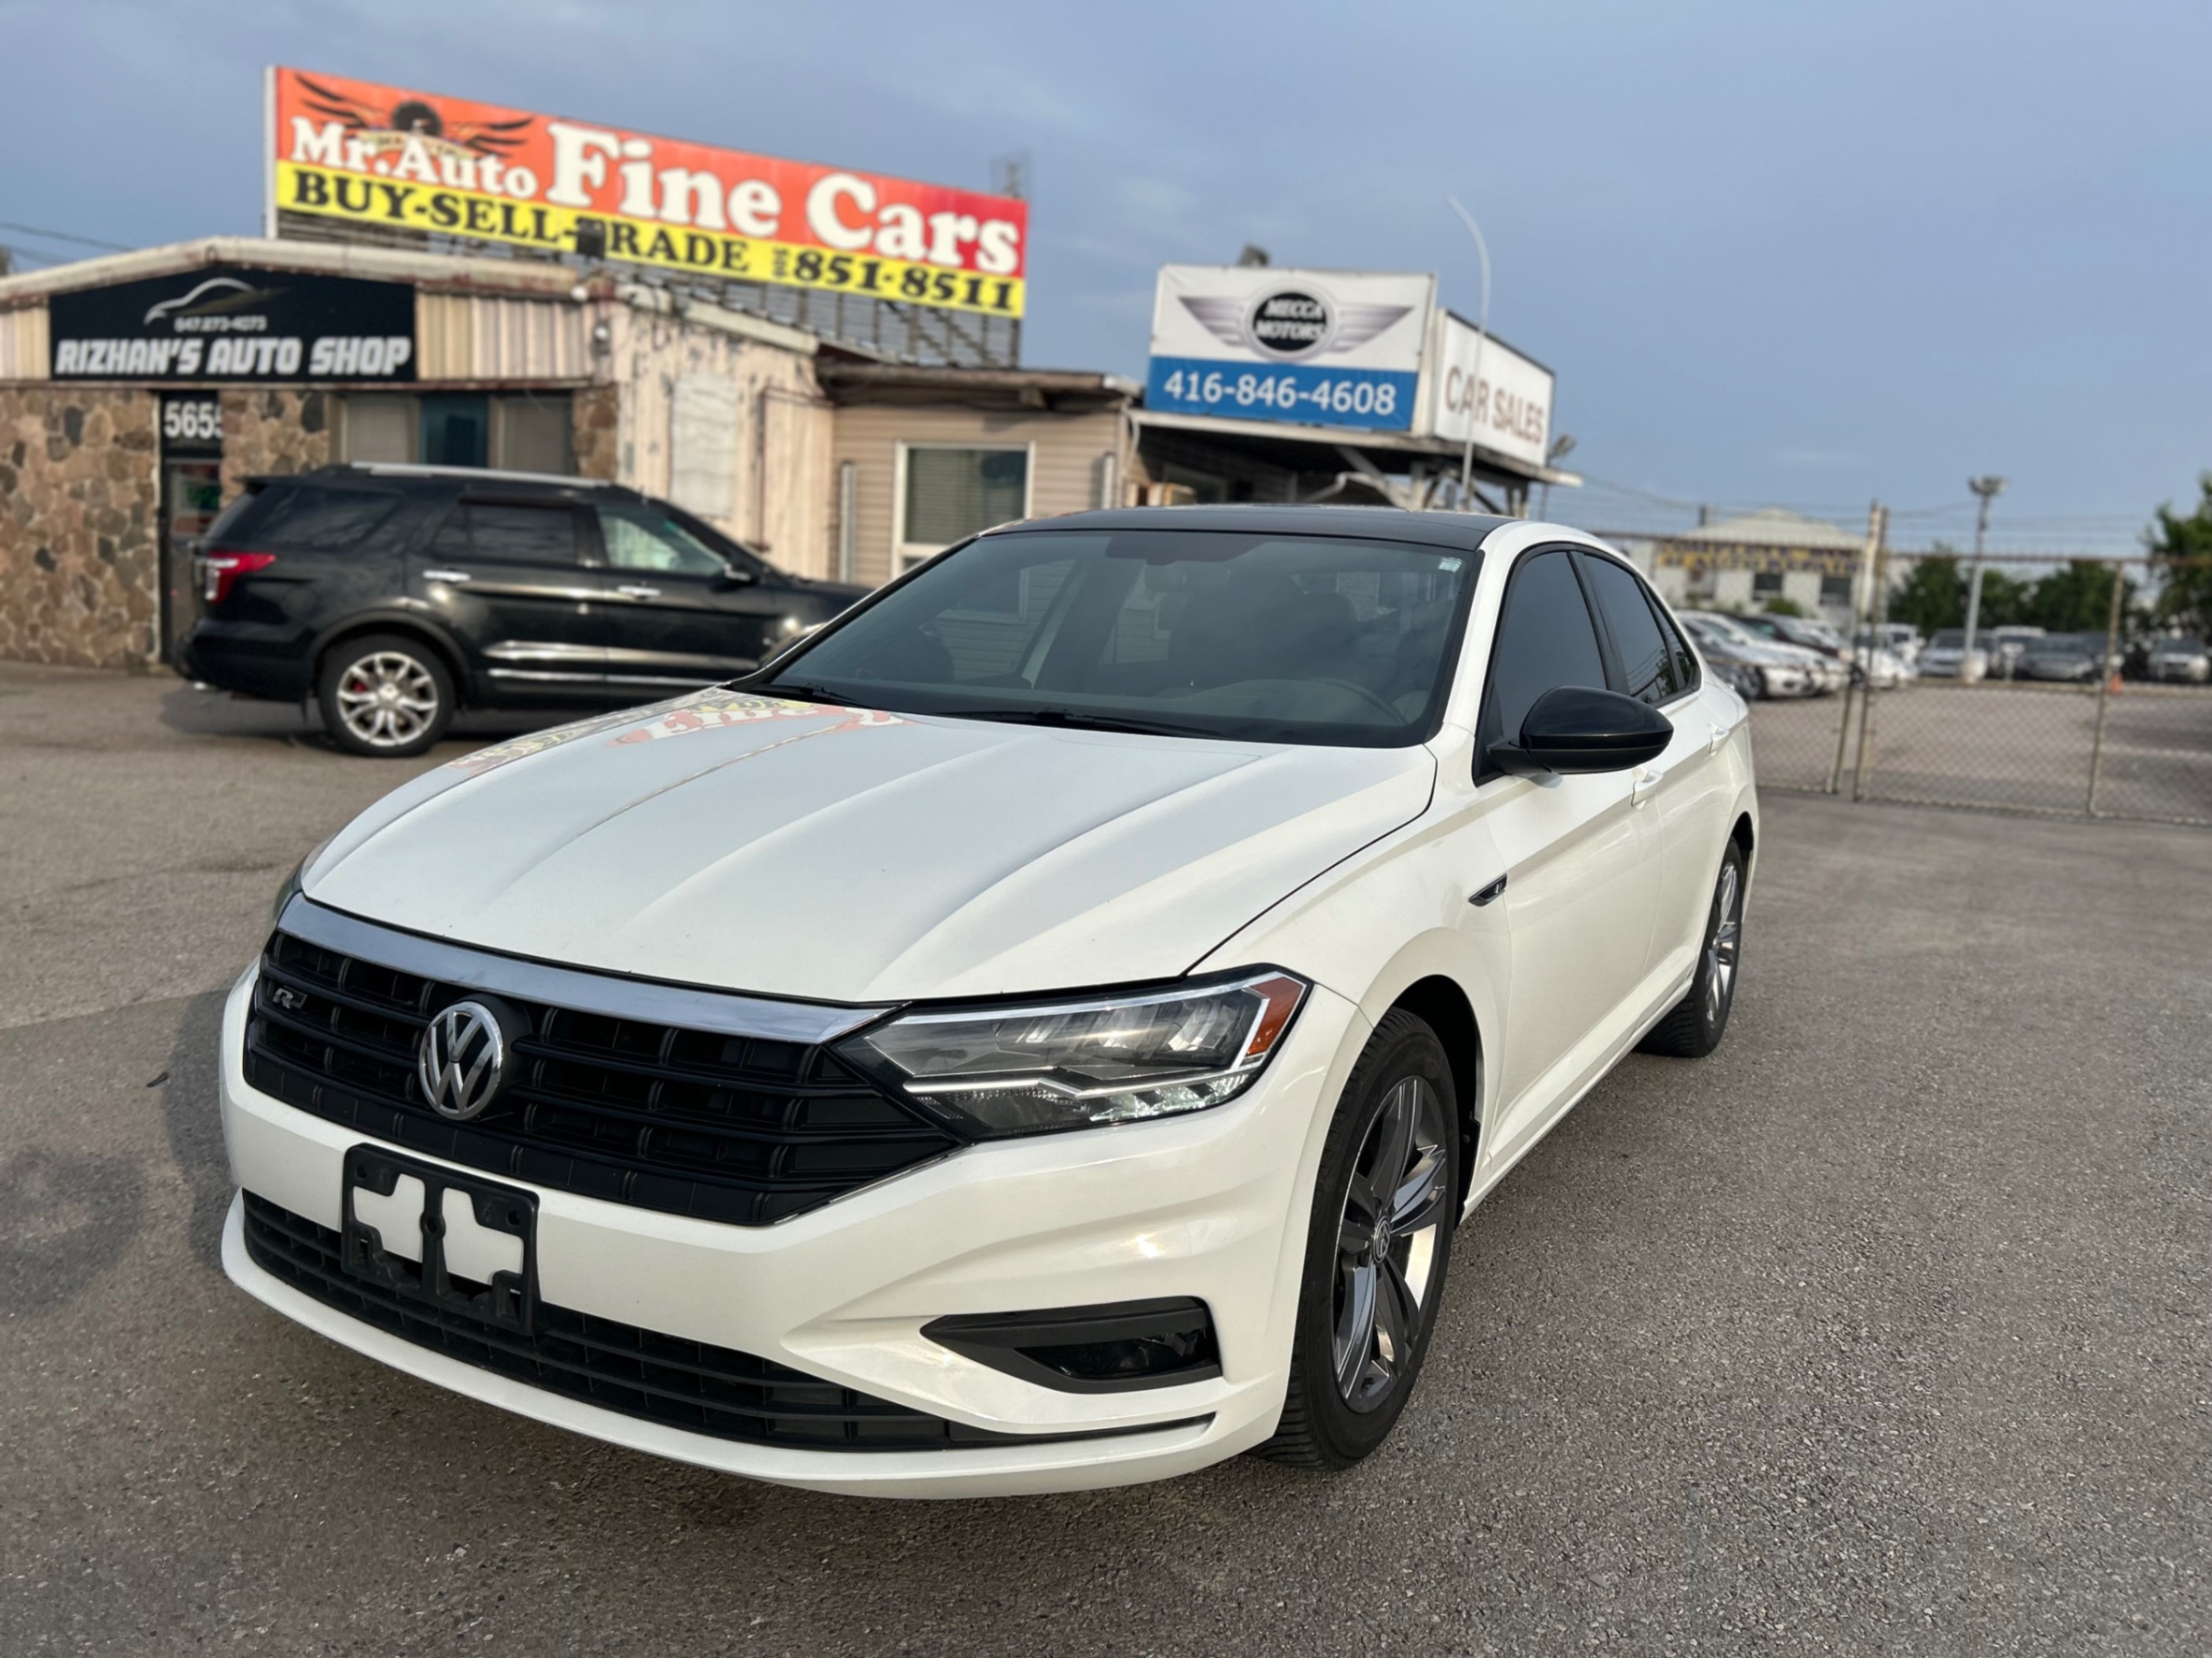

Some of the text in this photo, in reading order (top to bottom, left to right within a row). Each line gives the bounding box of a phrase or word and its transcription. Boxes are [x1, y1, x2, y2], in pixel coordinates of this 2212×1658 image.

[290, 116, 1019, 275] Mr.Auto Fine Cars
[294, 169, 749, 272] BUY-SELL-RADE
[54, 336, 412, 375] RIZHAN'S AUTO SHOP
[1256, 318, 1324, 340] MOTORS
[1165, 369, 1397, 416] 416-846-4608
[1445, 365, 1545, 445] CAR SALES
